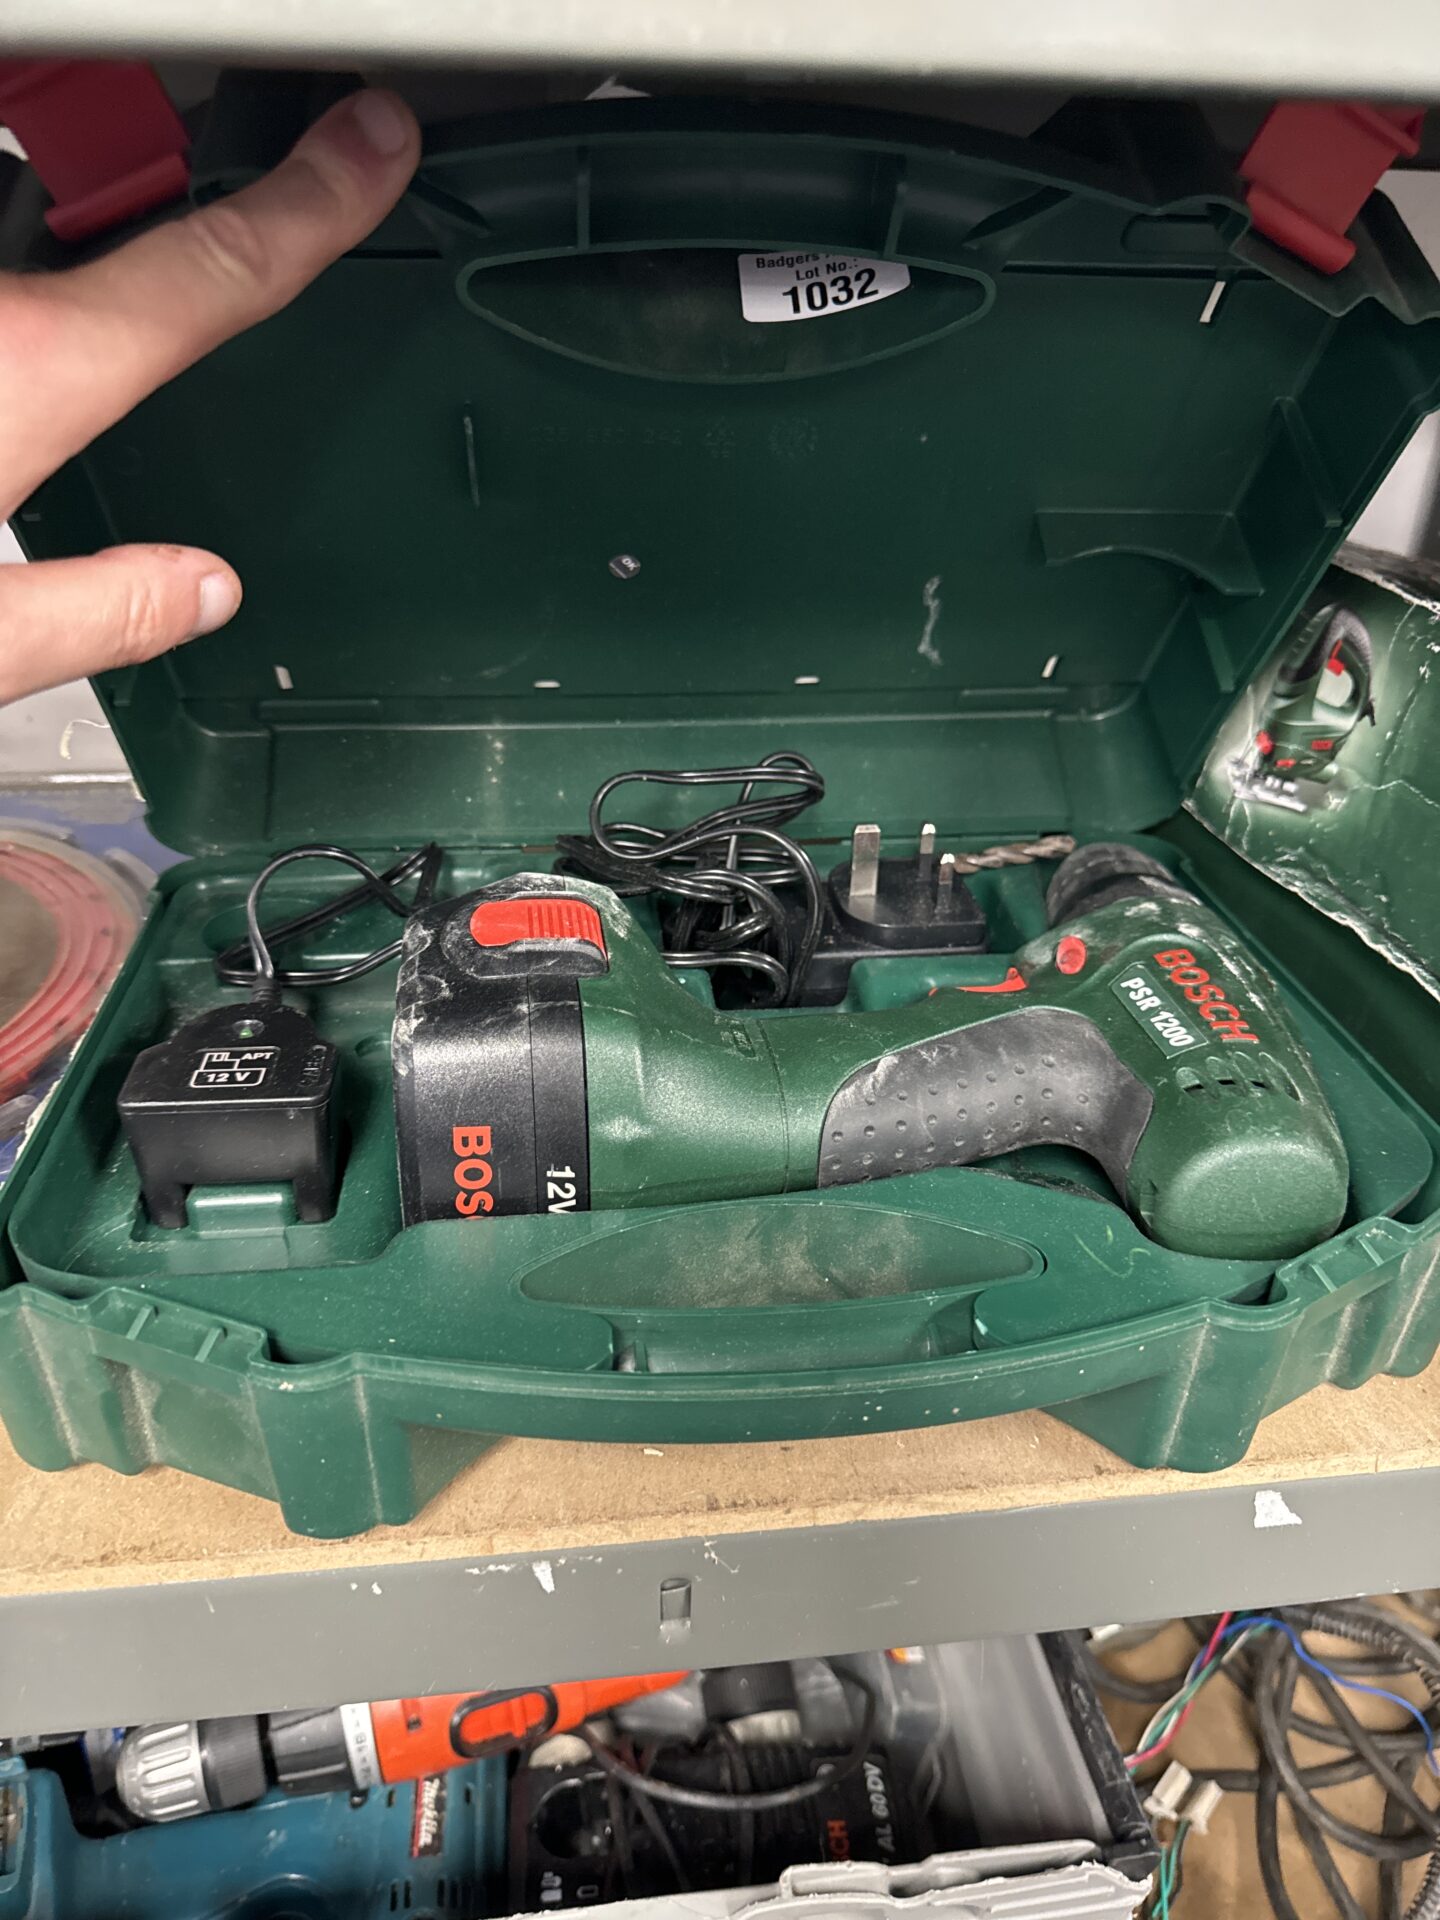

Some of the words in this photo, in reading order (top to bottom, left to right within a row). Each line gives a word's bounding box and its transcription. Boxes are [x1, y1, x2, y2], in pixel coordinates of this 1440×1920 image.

[756, 253, 820, 269] Badgers
[796, 268, 820, 281] Lot
[782, 267, 879, 314] 1032
[622, 558, 637, 571] OK
[1152, 948, 1260, 1044] BOSCH
[1120, 977, 1162, 1012] PSR
[1149, 1010, 1195, 1047] 1200
[240, 1051, 275, 1061] APT
[207, 1072, 230, 1083] 12
[235, 1071, 251, 1082] V
[452, 1125, 494, 1220] BOS
